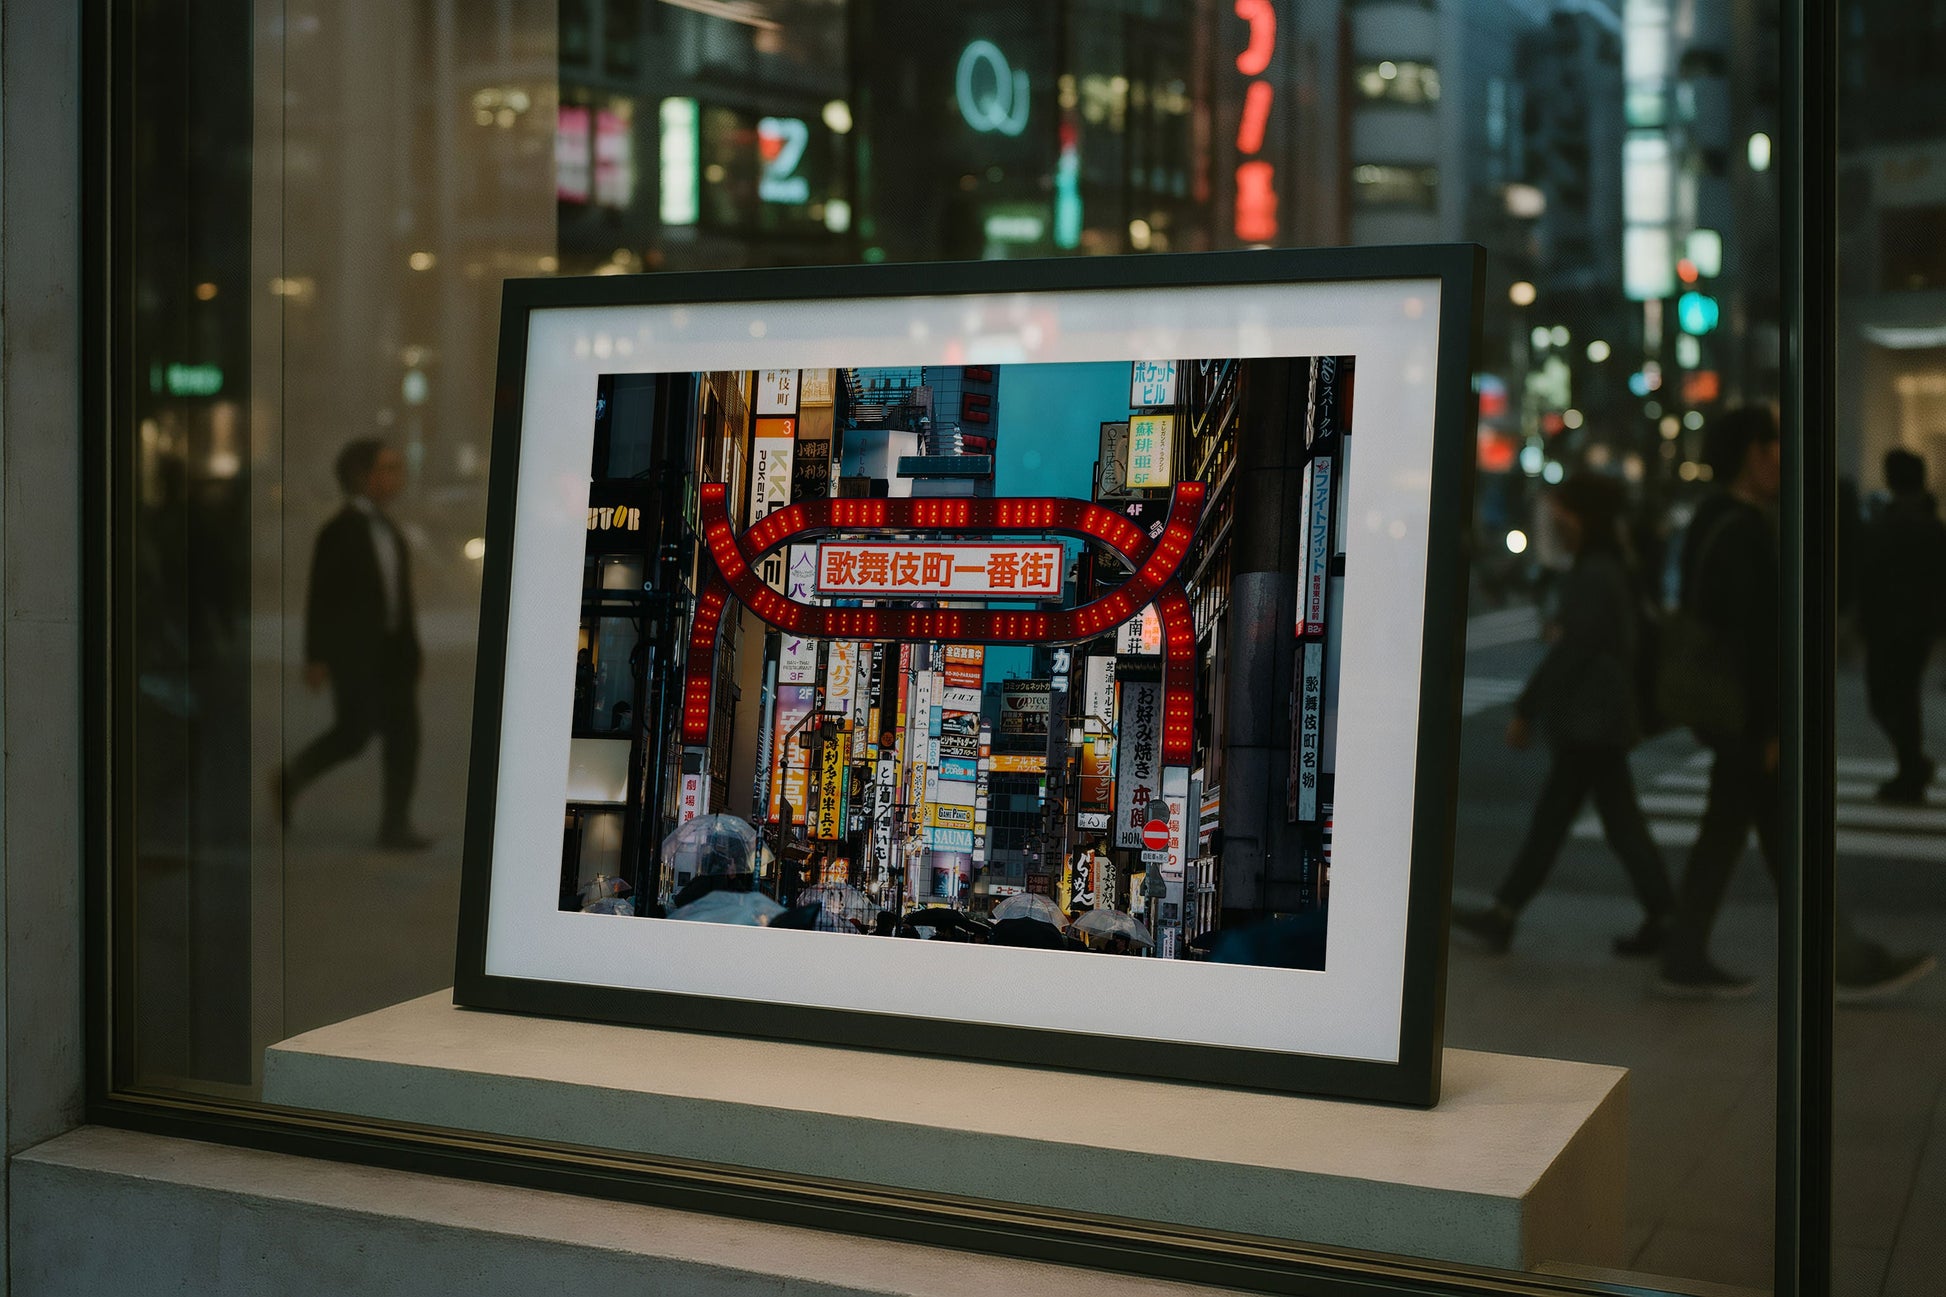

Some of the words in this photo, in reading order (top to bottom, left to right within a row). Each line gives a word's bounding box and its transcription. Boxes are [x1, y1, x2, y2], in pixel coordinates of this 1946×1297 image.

[1134, 362, 1175, 383] ポケット
[1143, 385, 1166, 404] ビル
[1318, 386, 1333, 439] スパークル
[783, 420, 791, 434] 3
[756, 450, 767, 503] POKER
[1134, 473, 1149, 484] 5F
[1126, 504, 1143, 516] 4F
[1313, 474, 1330, 572] ファイトフィット
[827, 550, 1053, 588] 歌舞伎町一番街
[789, 672, 804, 681] 3F
[798, 688, 813, 700] 2F
[1133, 687, 1154, 779] お好み焼き
[1302, 676, 1320, 789] 歌舞伎町名物
[935, 829, 973, 846] SAUNA
[1168, 803, 1181, 866] 劇場通り
